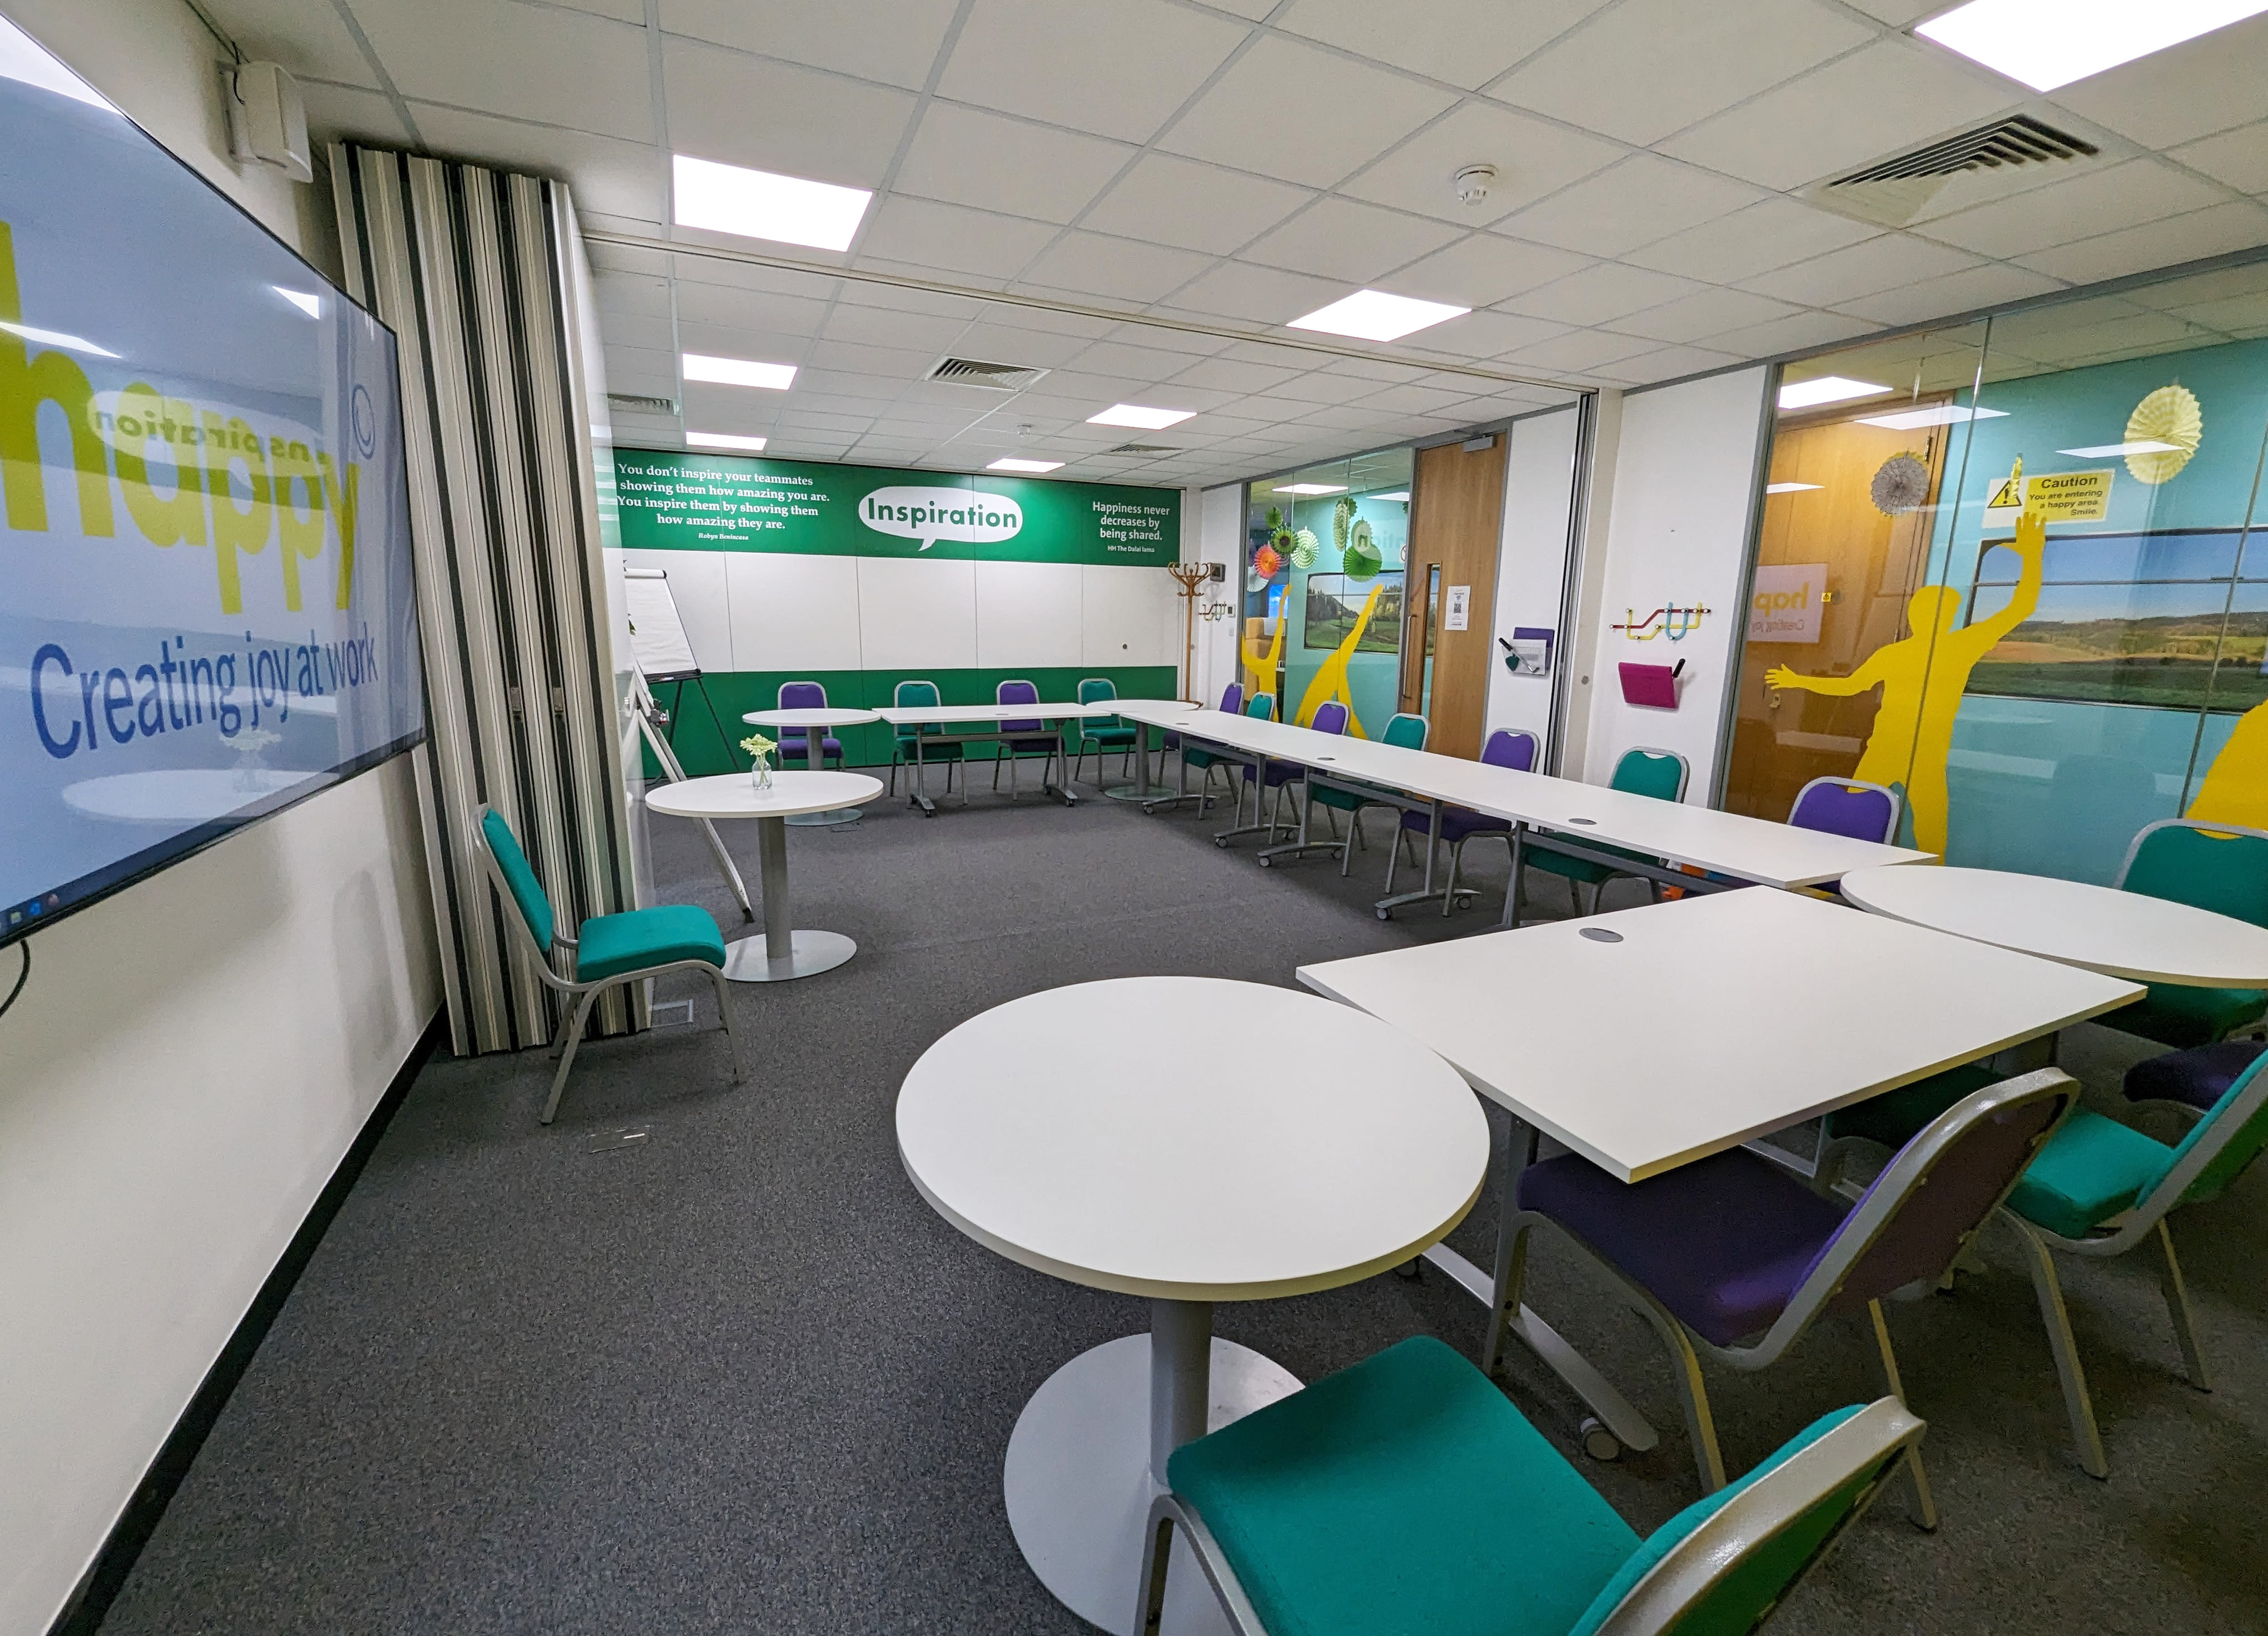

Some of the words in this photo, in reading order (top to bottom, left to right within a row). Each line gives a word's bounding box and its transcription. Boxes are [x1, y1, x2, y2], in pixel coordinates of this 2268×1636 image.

[0, 219, 360, 615] happy
[618, 463, 643, 475] You
[681, 468, 723, 481] inspire
[725, 473, 752, 483] your
[754, 474, 813, 486] teammates
[2041, 477, 2097, 489] Caution
[620, 480, 674, 495] showing
[676, 483, 706, 494] them
[709, 485, 734, 496] how
[737, 488, 785, 501] amazing
[787, 492, 808, 502] you
[2065, 490, 2103, 498] entering
[617, 495, 642, 507] You
[645, 497, 687, 511] inspire
[690, 500, 720, 510] them
[723, 501, 738, 514] by
[740, 503, 789, 517] showing
[790, 505, 819, 516] them
[868, 498, 1017, 529] Inspiration
[1092, 501, 1142, 515] Happiness
[1144, 506, 1170, 515] never
[656, 513, 683, 524] how
[686, 516, 736, 530] amazing
[738, 518, 763, 530] they
[765, 521, 785, 529] are.
[1101, 515, 1146, 526] decreases
[1148, 517, 1160, 530] by
[1100, 528, 1127, 541] being
[1129, 529, 1162, 540] shared.
[31, 635, 241, 759] Creating
[247, 631, 290, 727] joy
[297, 628, 324, 698] at
[328, 622, 379, 691] work
